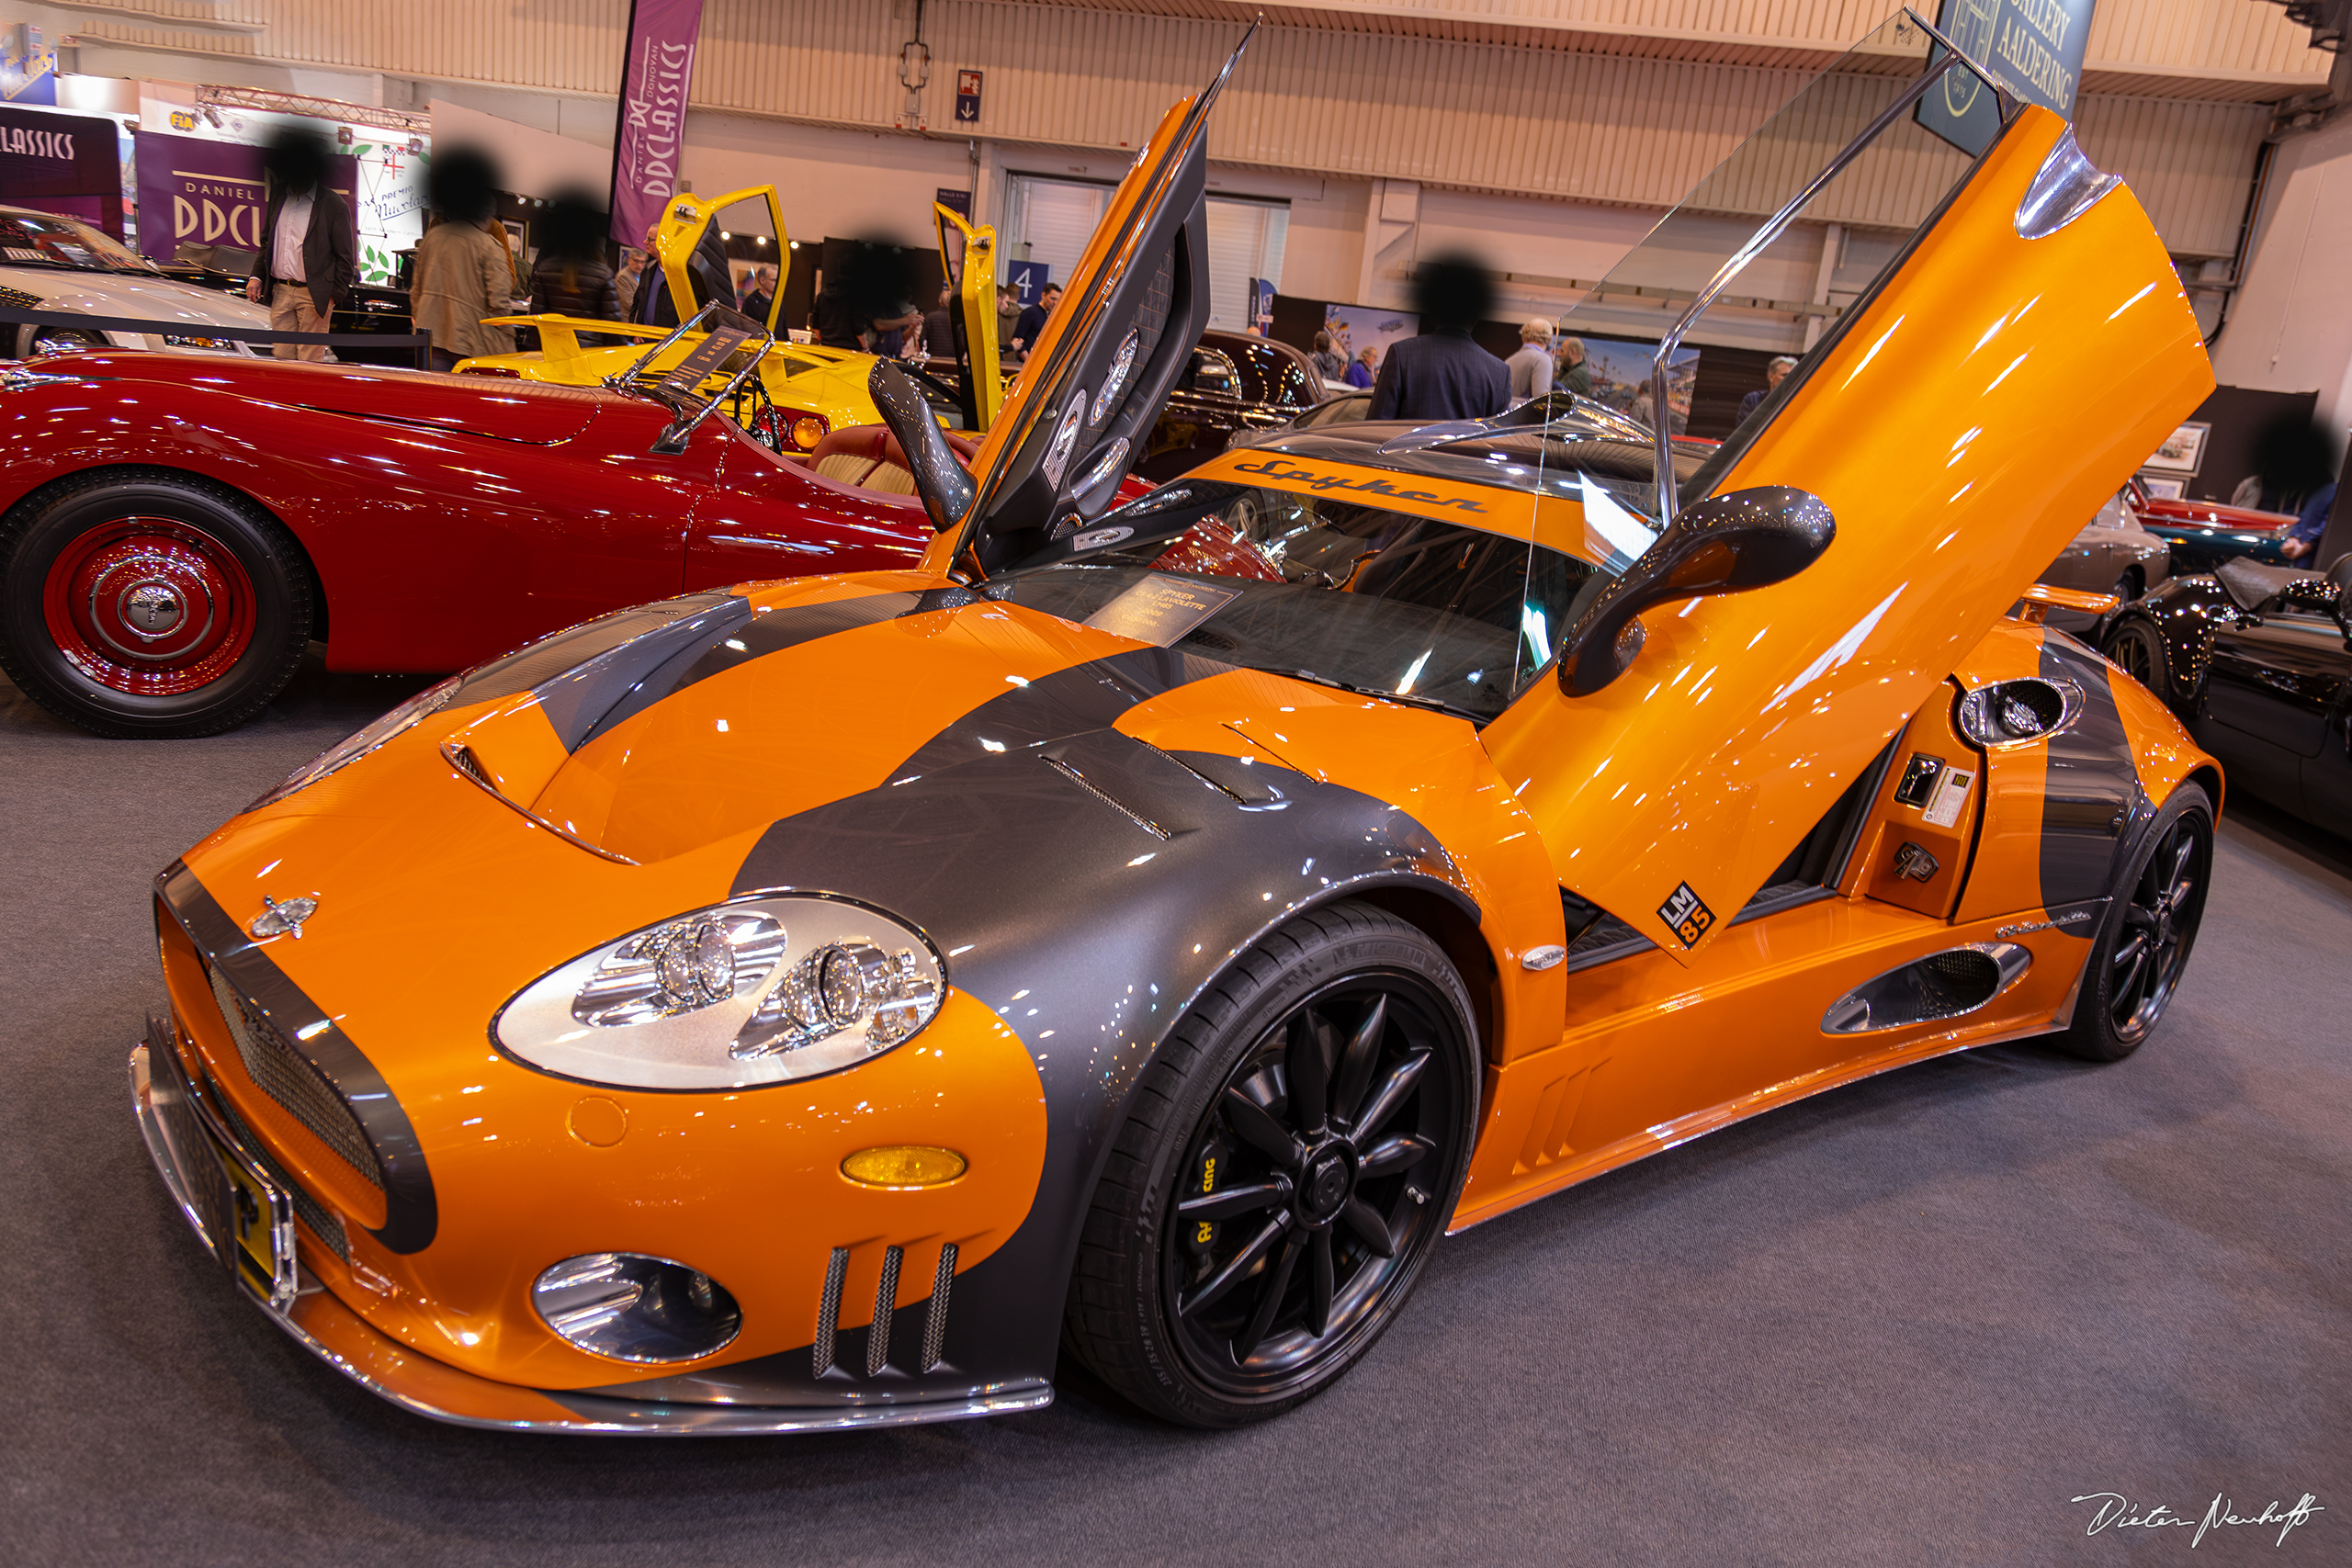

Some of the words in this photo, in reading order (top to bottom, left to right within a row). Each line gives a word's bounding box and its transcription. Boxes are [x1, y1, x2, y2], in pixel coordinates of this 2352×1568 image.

[647, 45, 660, 98] DONOVAN
[1996, 16, 2073, 110] AALDERING
[643, 39, 687, 198] DDCLASSICS
[0, 126, 75, 161] LASSICS
[185, 182, 255, 201] DANIEL
[1014, 267, 1033, 299] 4
[1233, 460, 1489, 514] Spyker
[1660, 885, 1696, 925] LM
[1679, 905, 1711, 943] 85
